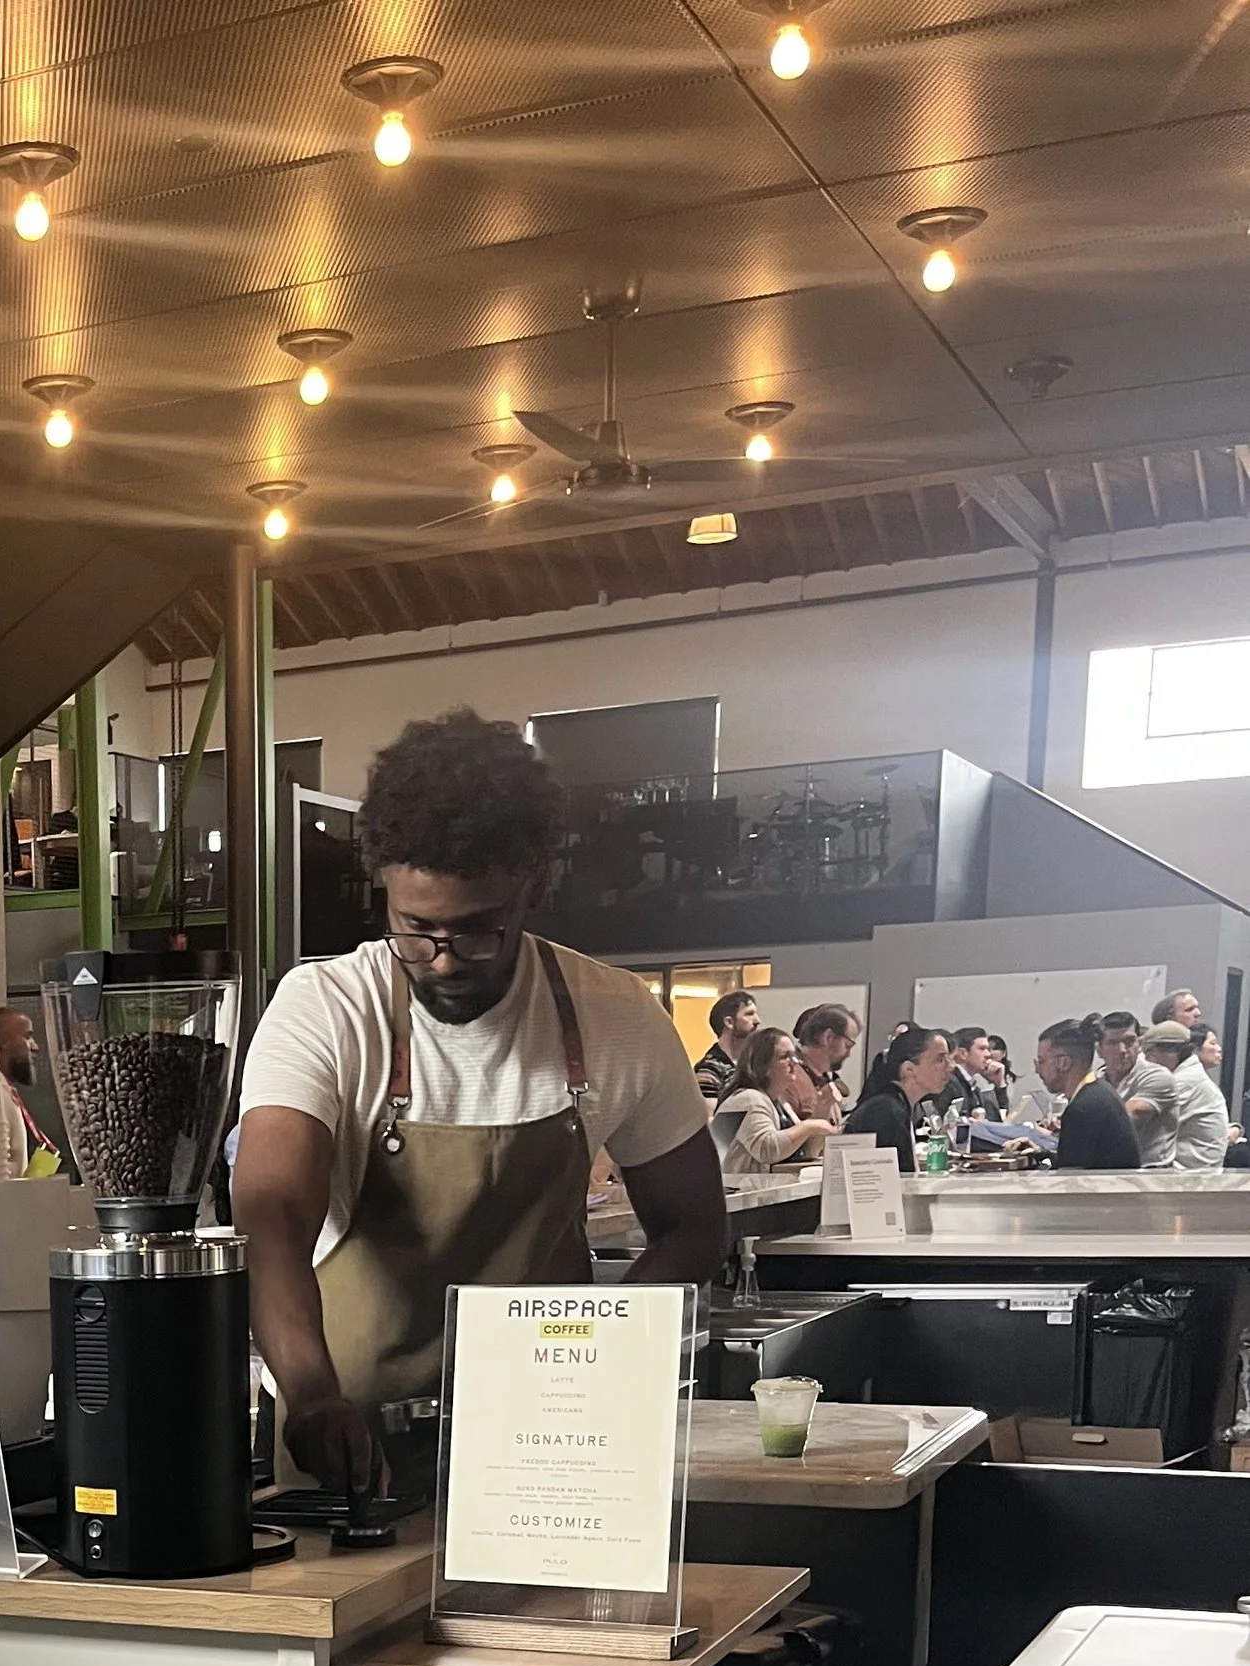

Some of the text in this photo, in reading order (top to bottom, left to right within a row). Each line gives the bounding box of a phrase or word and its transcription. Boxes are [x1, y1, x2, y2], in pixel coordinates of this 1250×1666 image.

[508, 1299, 629, 1318] AIRSPACE
[543, 1324, 590, 1335] COFFEE
[534, 1347, 598, 1364] MENU
[550, 1376, 575, 1384] LATTE
[515, 1433, 608, 1447] SIGNATURE
[509, 1514, 603, 1530] CUSTOMIZE
